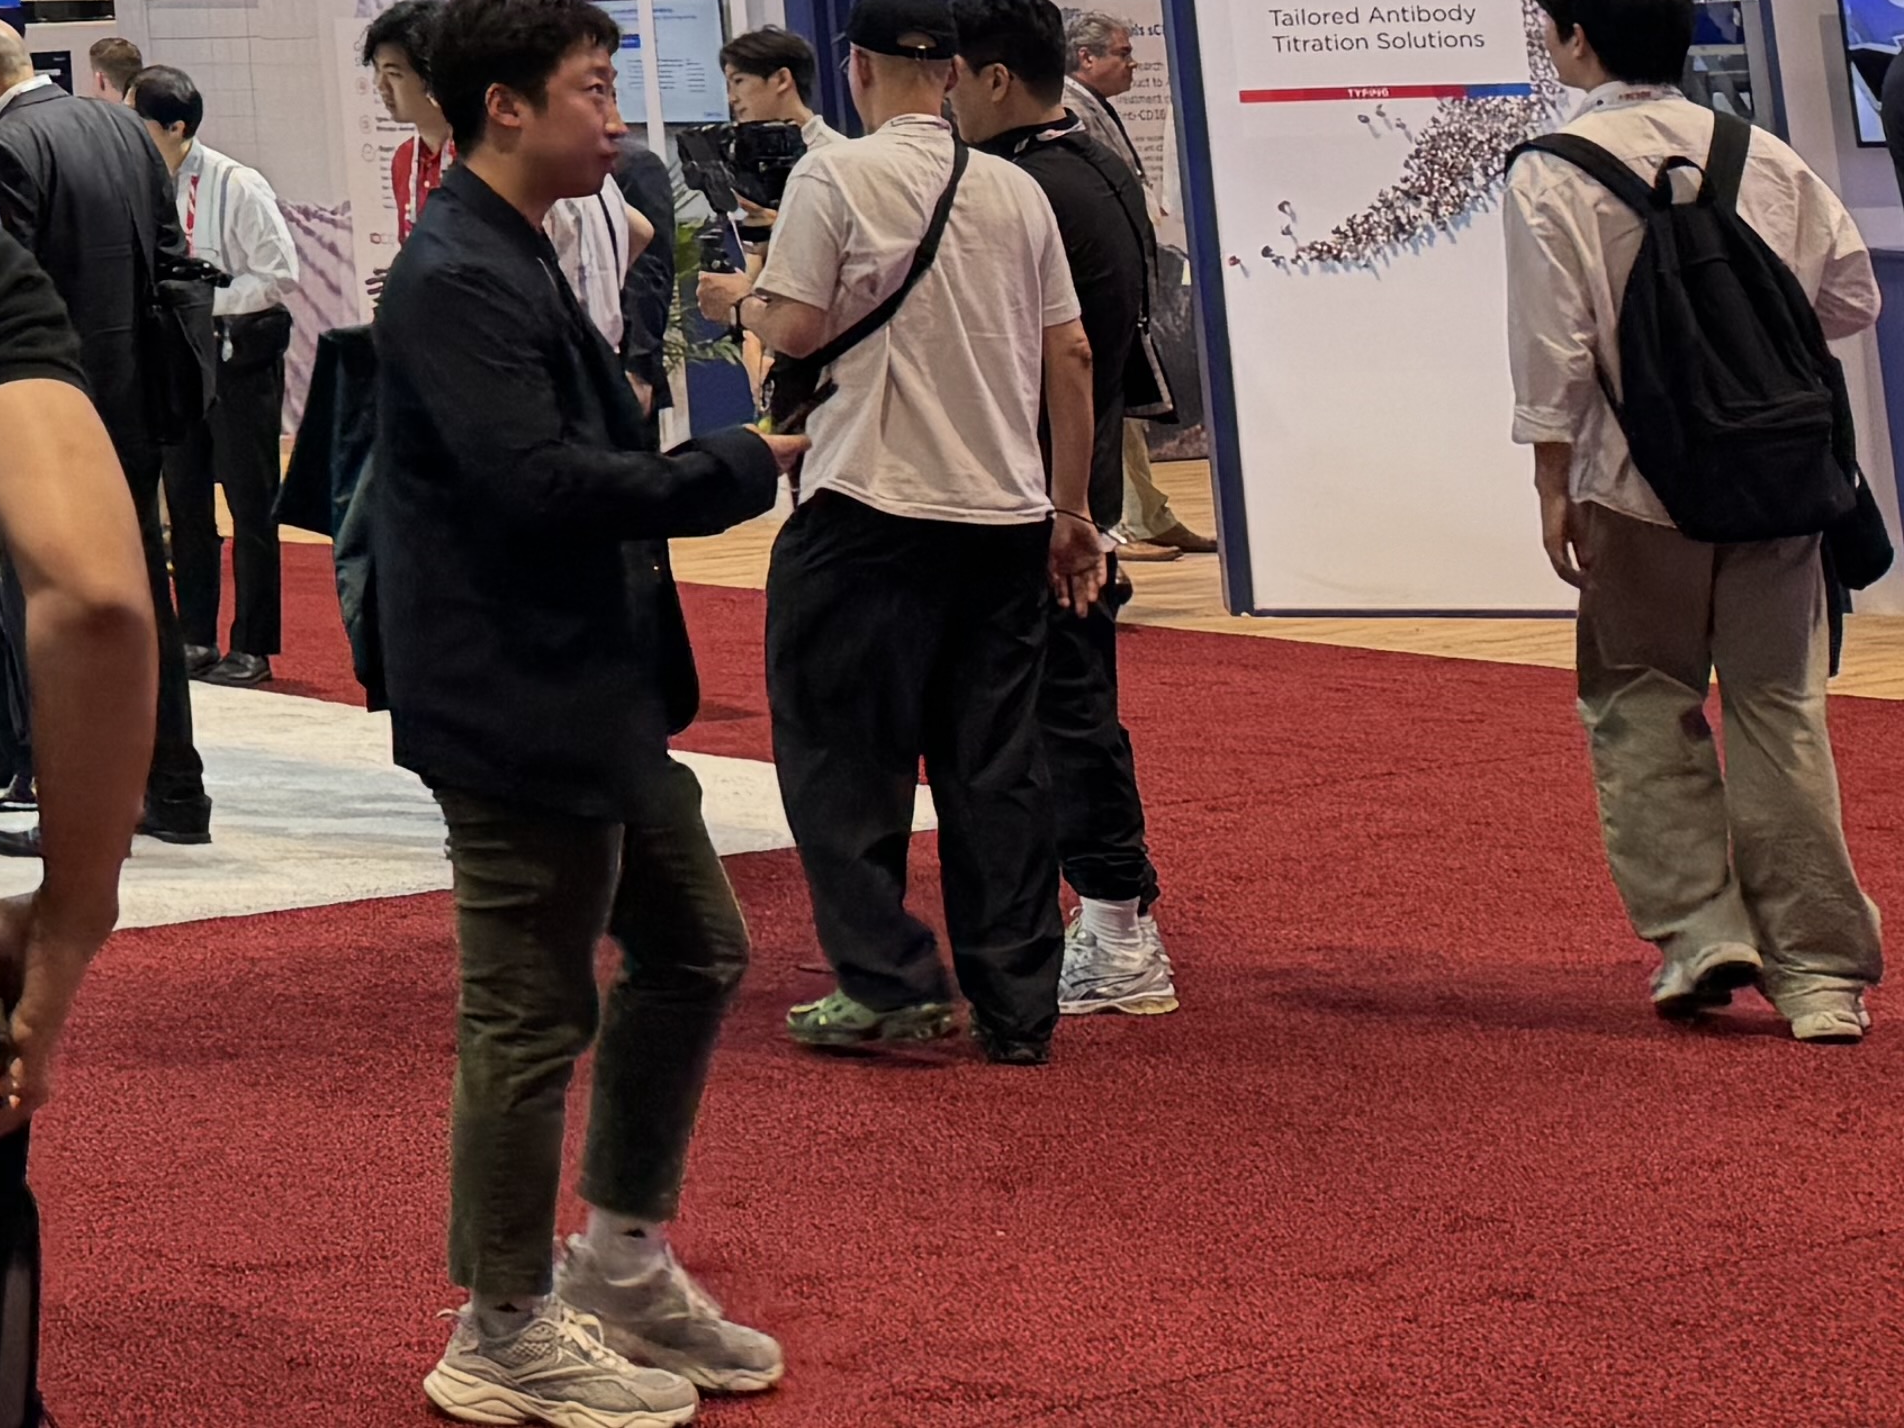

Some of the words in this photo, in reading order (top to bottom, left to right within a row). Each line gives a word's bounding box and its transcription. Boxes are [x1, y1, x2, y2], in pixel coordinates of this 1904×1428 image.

[1269, 6, 1359, 27] Tailored
[1369, 4, 1476, 24] Antibody
[1272, 34, 1368, 53] Titration
[1377, 31, 1485, 51] Solutions
